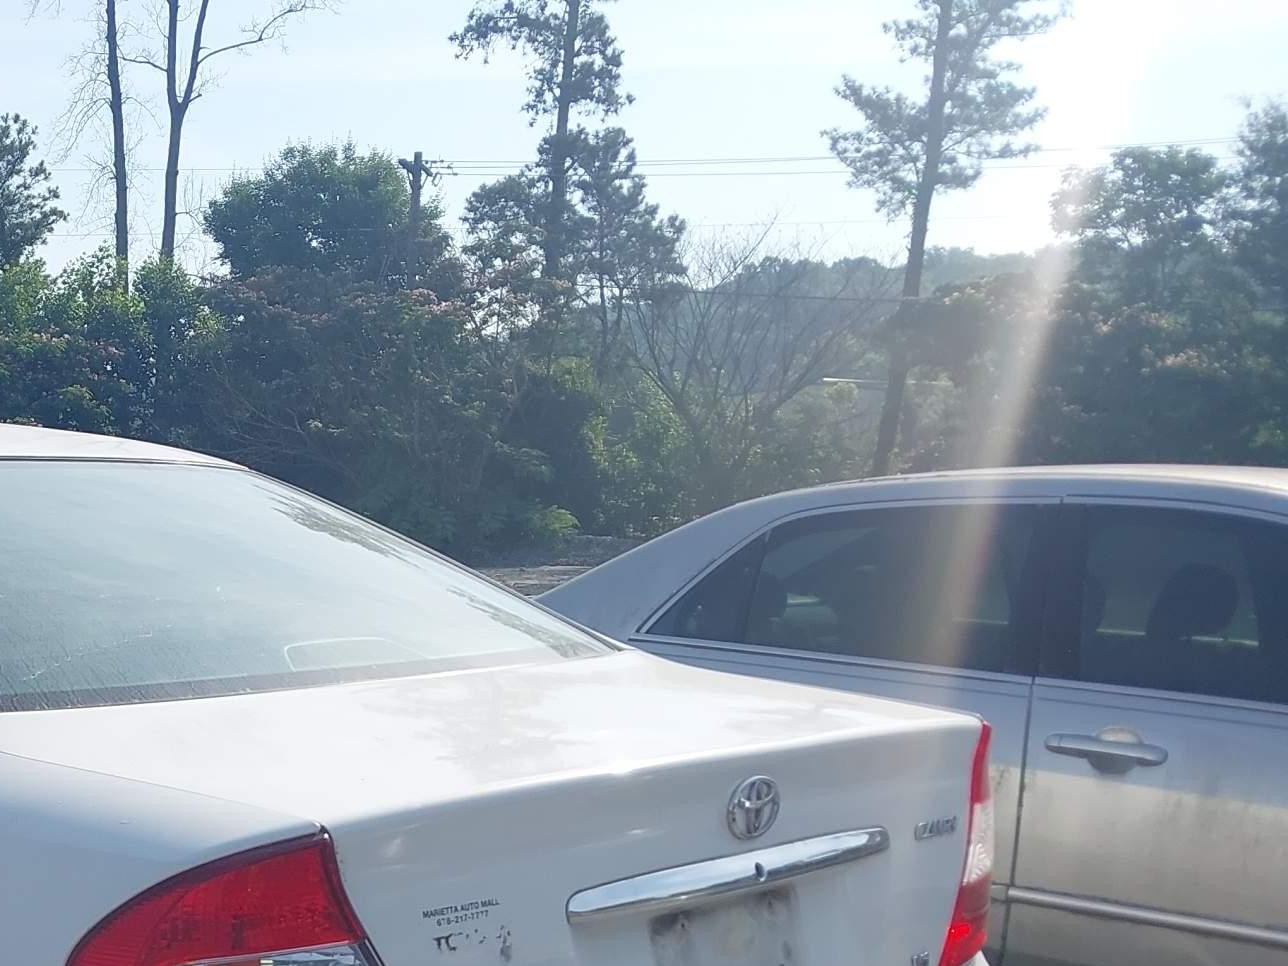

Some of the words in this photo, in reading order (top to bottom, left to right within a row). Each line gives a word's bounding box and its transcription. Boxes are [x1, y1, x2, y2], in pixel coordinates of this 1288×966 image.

[422, 905, 459, 919] MARIETTA
[460, 901, 480, 912] AUTO
[480, 898, 500, 908] MALL
